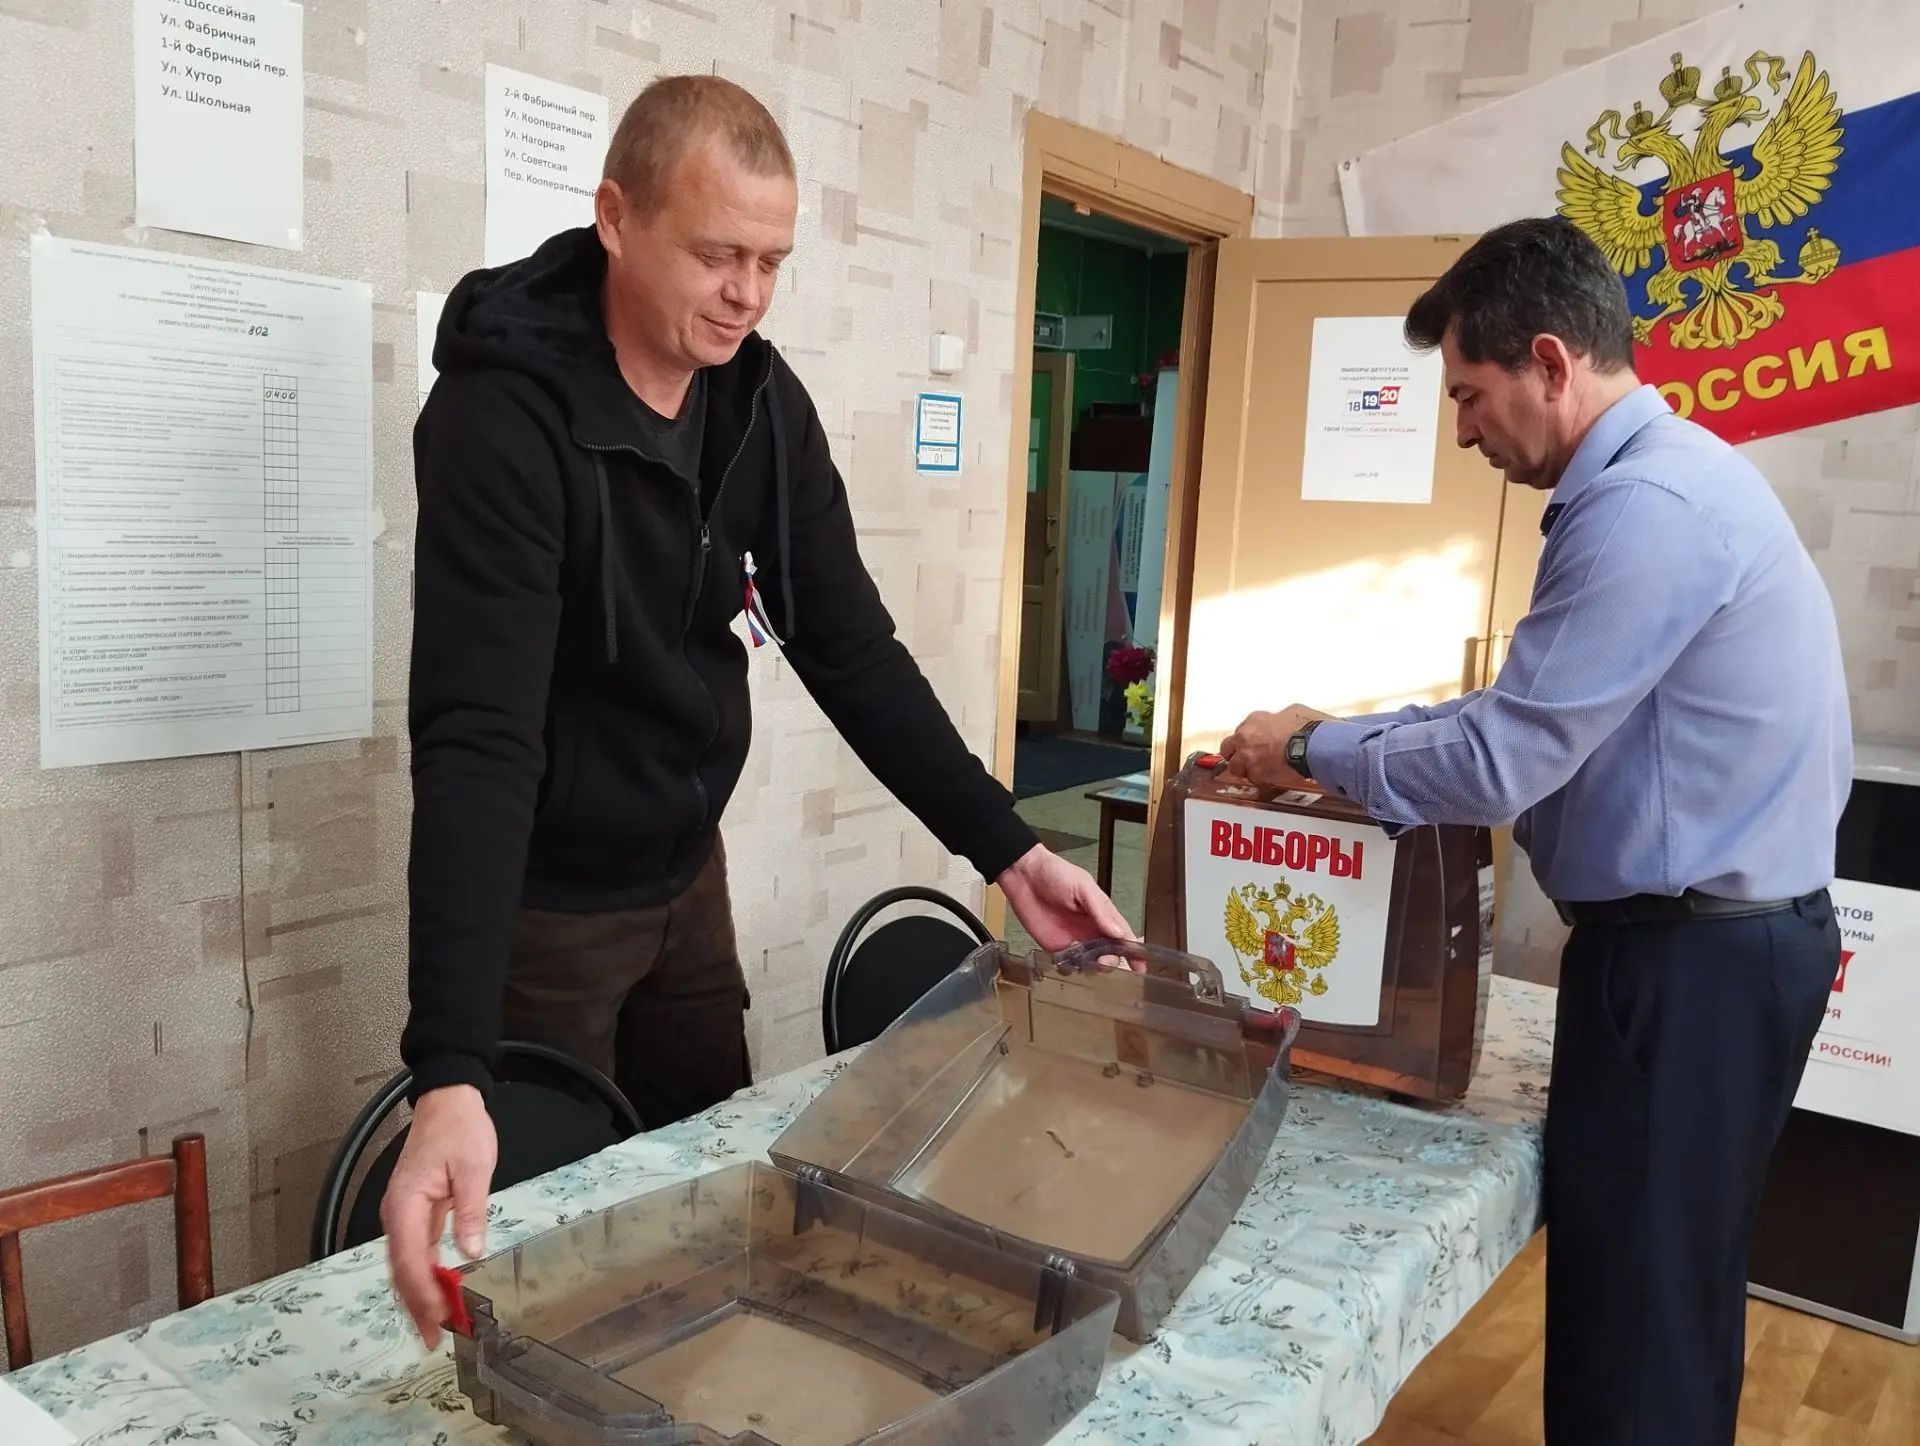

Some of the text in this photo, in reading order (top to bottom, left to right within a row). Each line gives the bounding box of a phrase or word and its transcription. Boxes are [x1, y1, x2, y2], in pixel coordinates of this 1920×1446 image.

[184, 0, 256, 23] Шоссейная
[159, 12, 256, 46] Ул. Фабричная
[161, 37, 289, 78] 1-й Фабричный пер.
[161, 60, 222, 86] Ул. Хутор
[161, 84, 251, 114] Ул. Школьная
[504, 87, 598, 123] 2-й Фабричный пер.
[504, 107, 592, 140] Ул. Кооперативная
[504, 127, 566, 153] Ул. Нагорная
[504, 147, 568, 173] Ул. Советская
[504, 168, 596, 198] Пер. Кооперативный
[248, 325, 269, 337] 802
[1657, 326, 1893, 420] ОССИЯ
[265, 390, 296, 400] 0400
[1348, 389, 1398, 411] 18 19 20
[1210, 819, 1363, 880] ВЫБОРЫ
[1832, 905, 1873, 922] АТОВ
[1820, 1043, 1892, 1067] РОССИИ!
